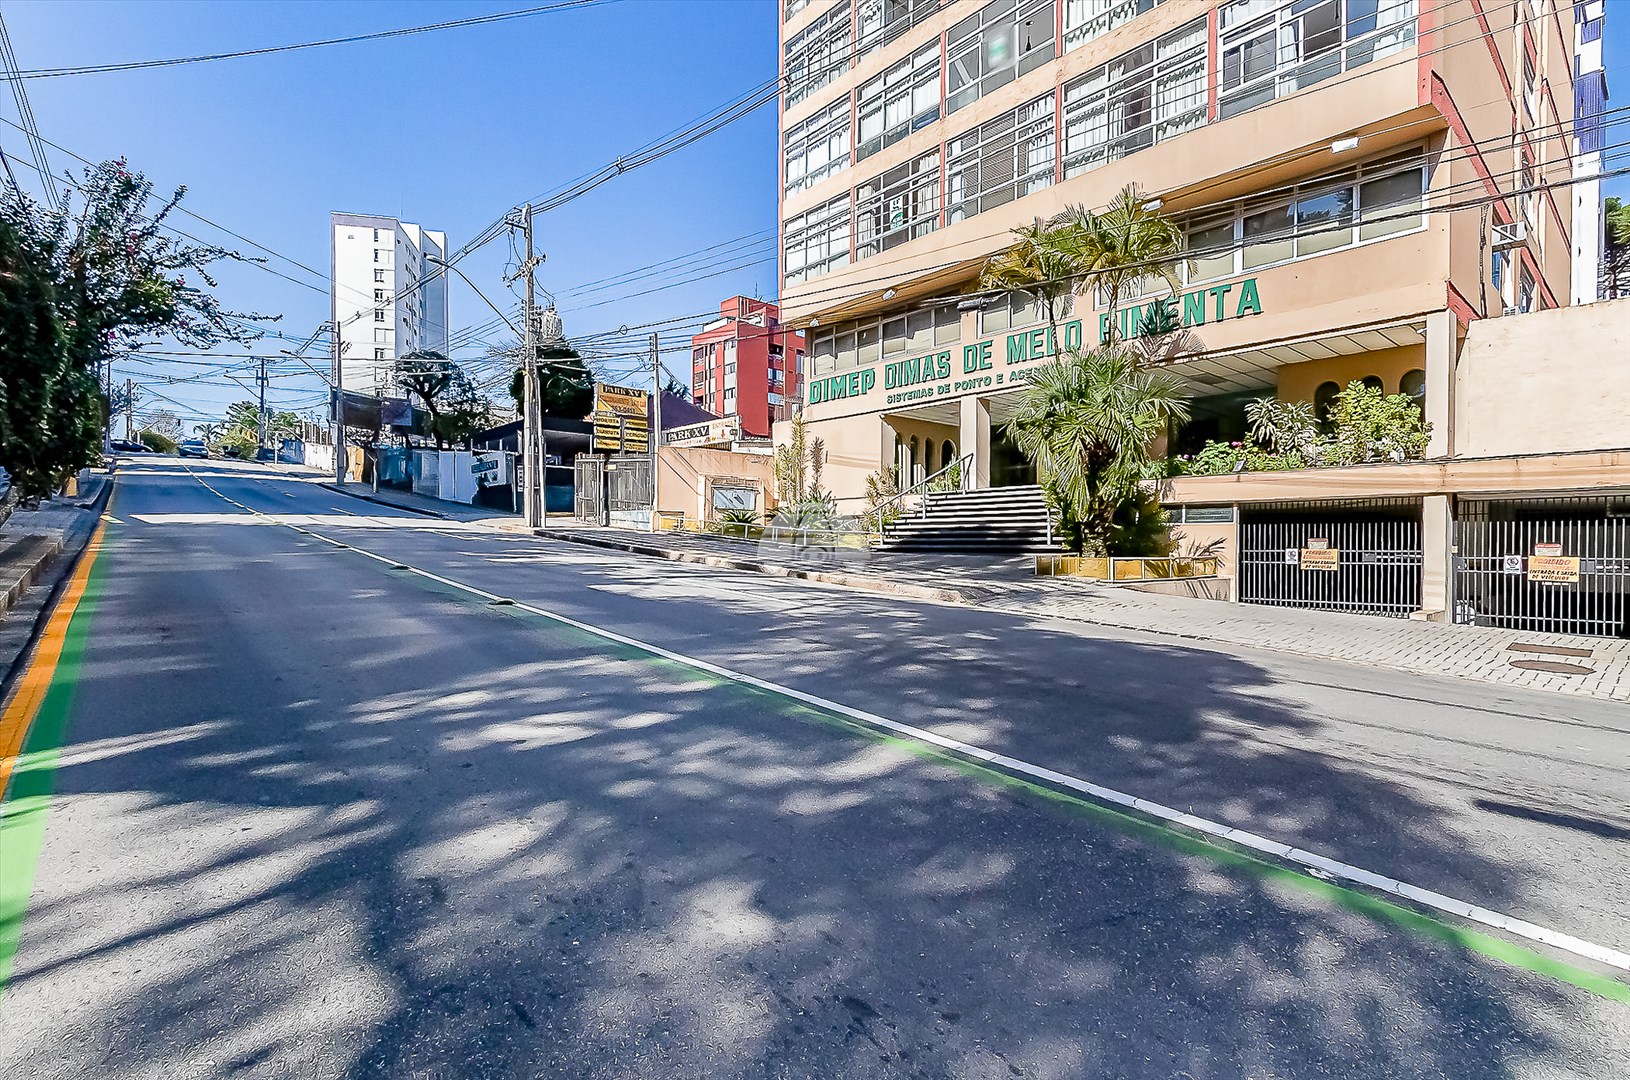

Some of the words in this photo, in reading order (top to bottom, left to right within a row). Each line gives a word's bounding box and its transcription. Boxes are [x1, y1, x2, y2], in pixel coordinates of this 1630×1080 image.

[809, 367, 876, 404] DIMEP
[885, 351, 951, 391] DIMAS
[963, 340, 994, 374] DE
[1006, 319, 1083, 365] MELO
[604, 385, 626, 395] PARK
[628, 388, 641, 397] XV
[887, 387, 933, 403] SISTEMAS
[937, 385, 951, 395] DE
[954, 375, 992, 392] PONTO
[996, 373, 1004, 384] E
[668, 428, 691, 442] PARK
[692, 426, 708, 437] XV
[1534, 558, 1571, 566] PROIBIDO
